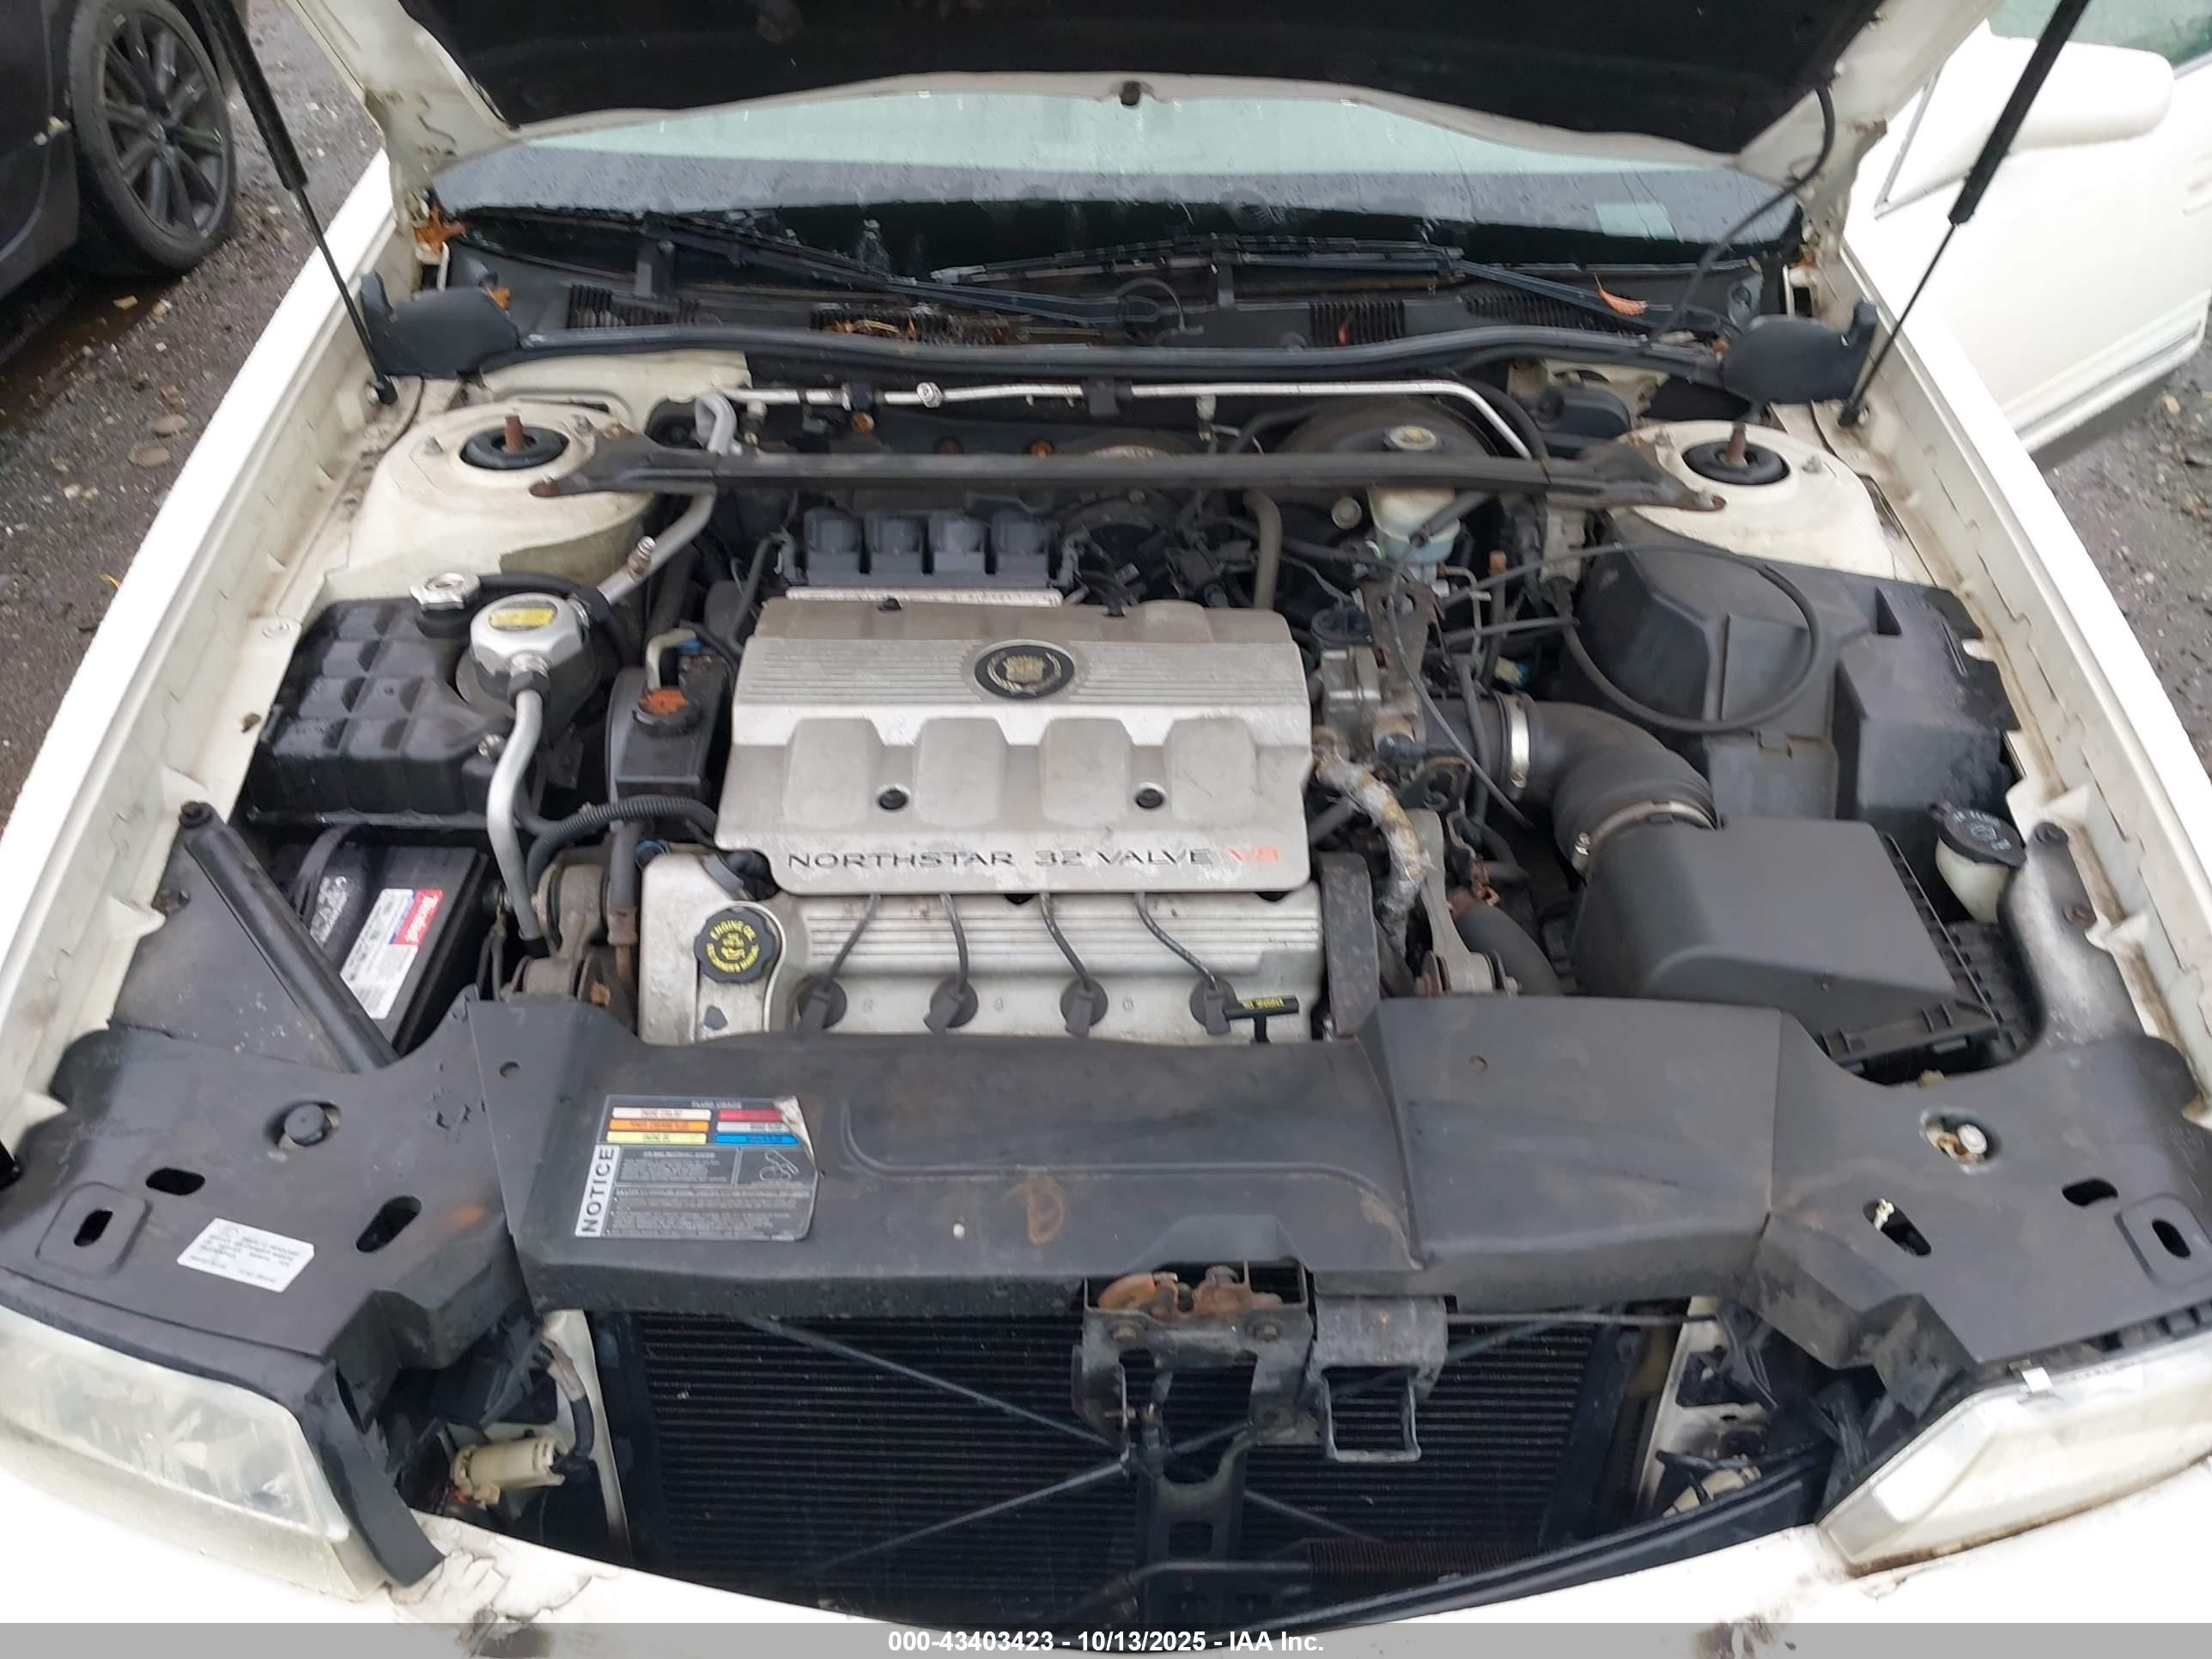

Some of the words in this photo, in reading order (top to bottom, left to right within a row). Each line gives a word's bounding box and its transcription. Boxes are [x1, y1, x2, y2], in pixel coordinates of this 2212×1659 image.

[788, 851, 1015, 868] NORTHSTAR
[1035, 848, 1085, 866] 32
[1094, 848, 1212, 866] VALVE
[1226, 846, 1278, 866] V8
[709, 920, 744, 941] ENGINE
[581, 1147, 615, 1234] NOTICE
